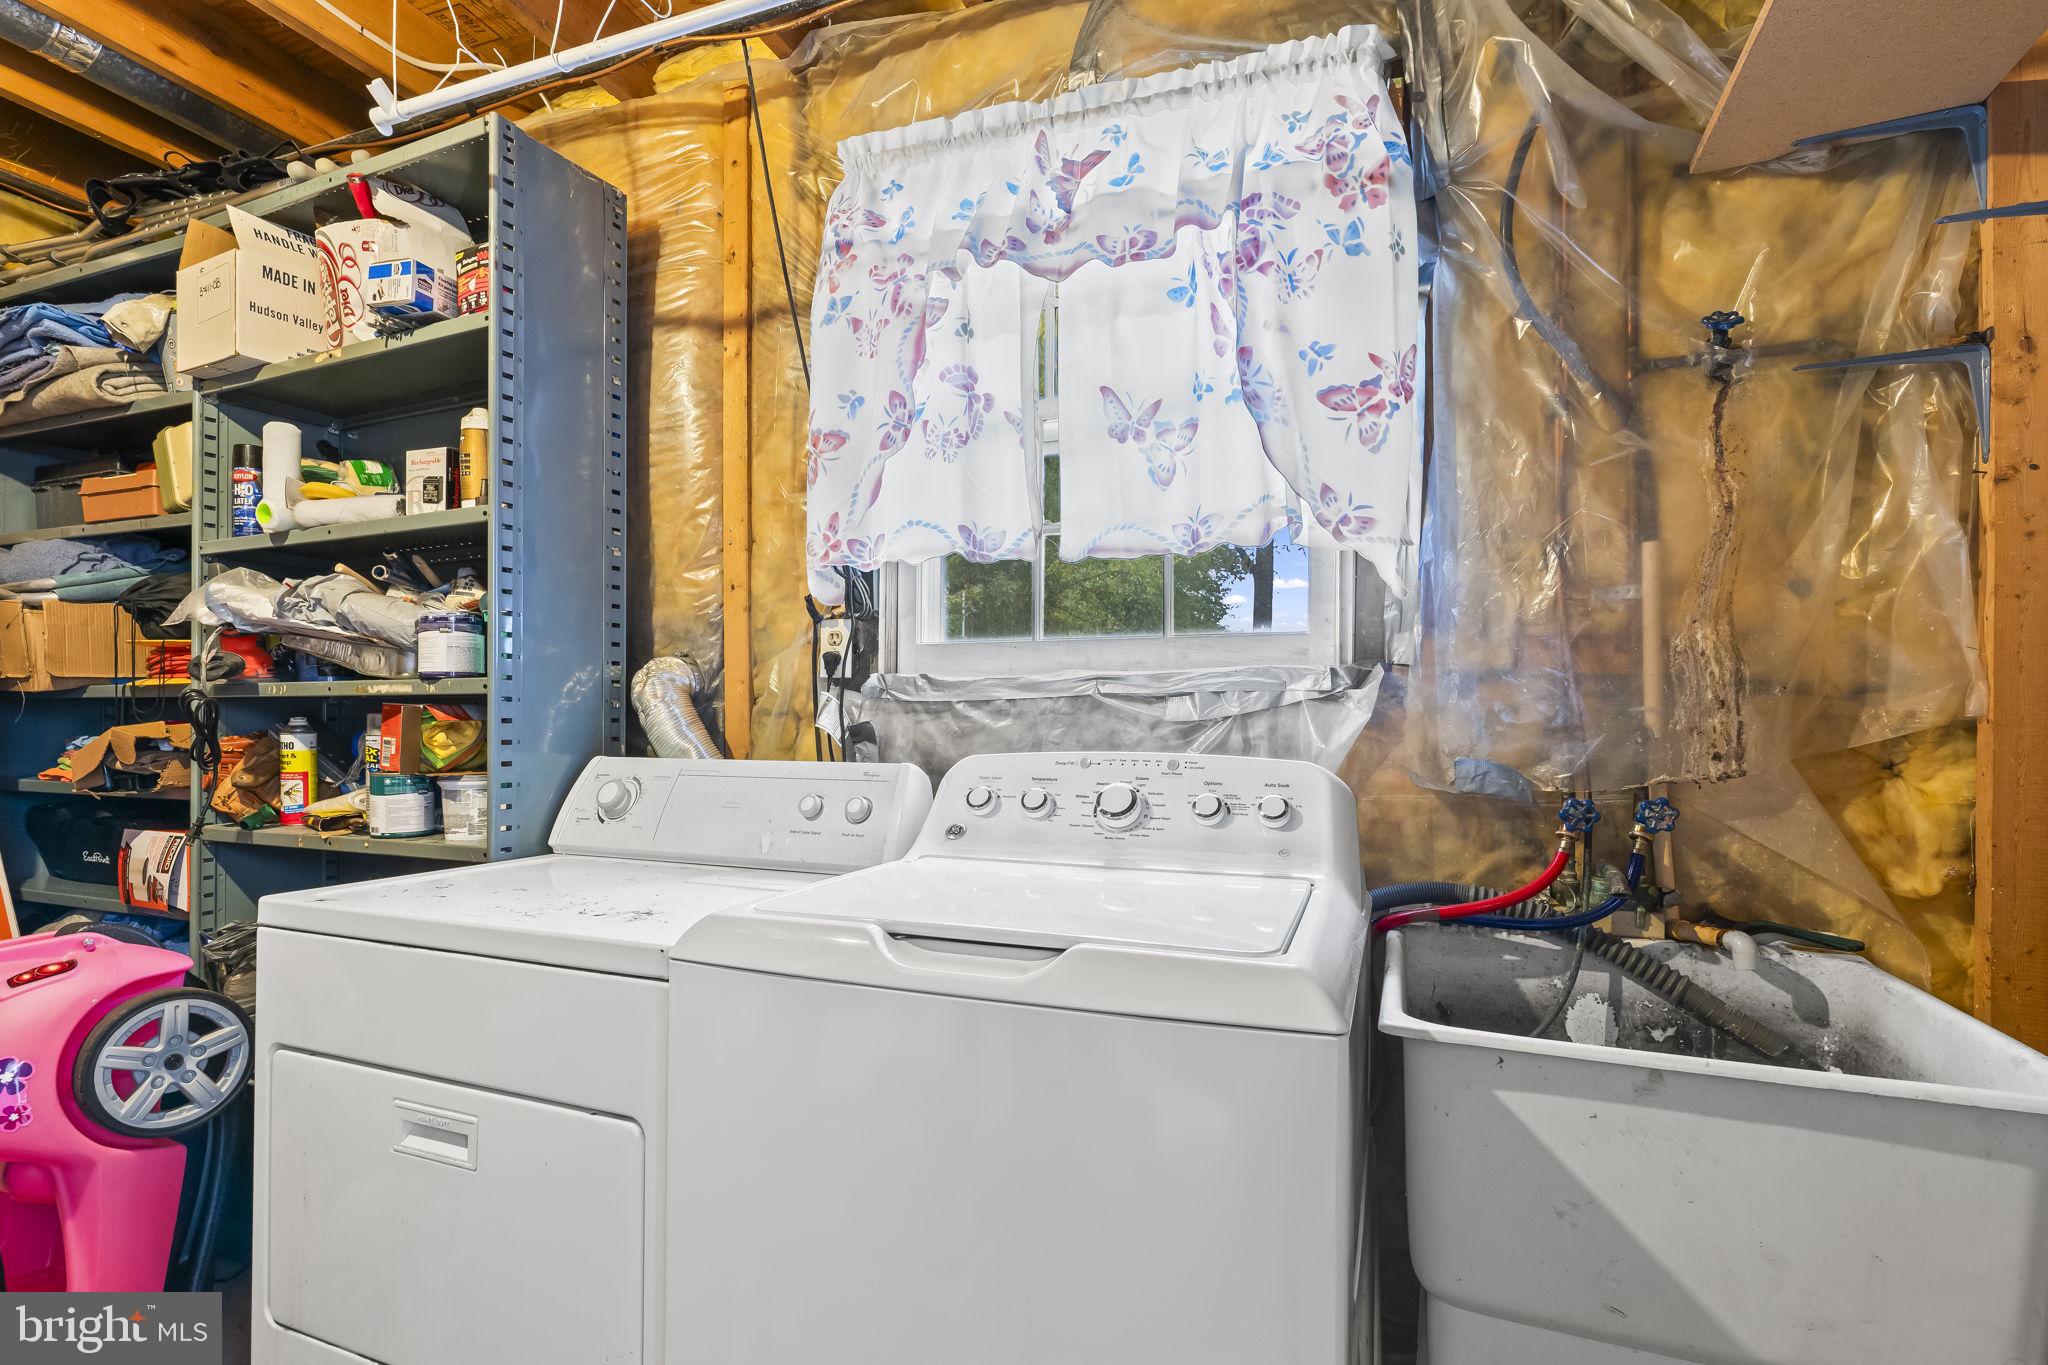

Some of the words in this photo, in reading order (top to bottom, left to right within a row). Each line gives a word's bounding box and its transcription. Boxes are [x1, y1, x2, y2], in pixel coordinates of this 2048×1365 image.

[253, 228, 305, 255] HANDLE
[262, 264, 299, 290] MADE
[303, 278, 316, 295] IN
[249, 300, 289, 322] Hudson
[293, 314, 324, 334] Valley
